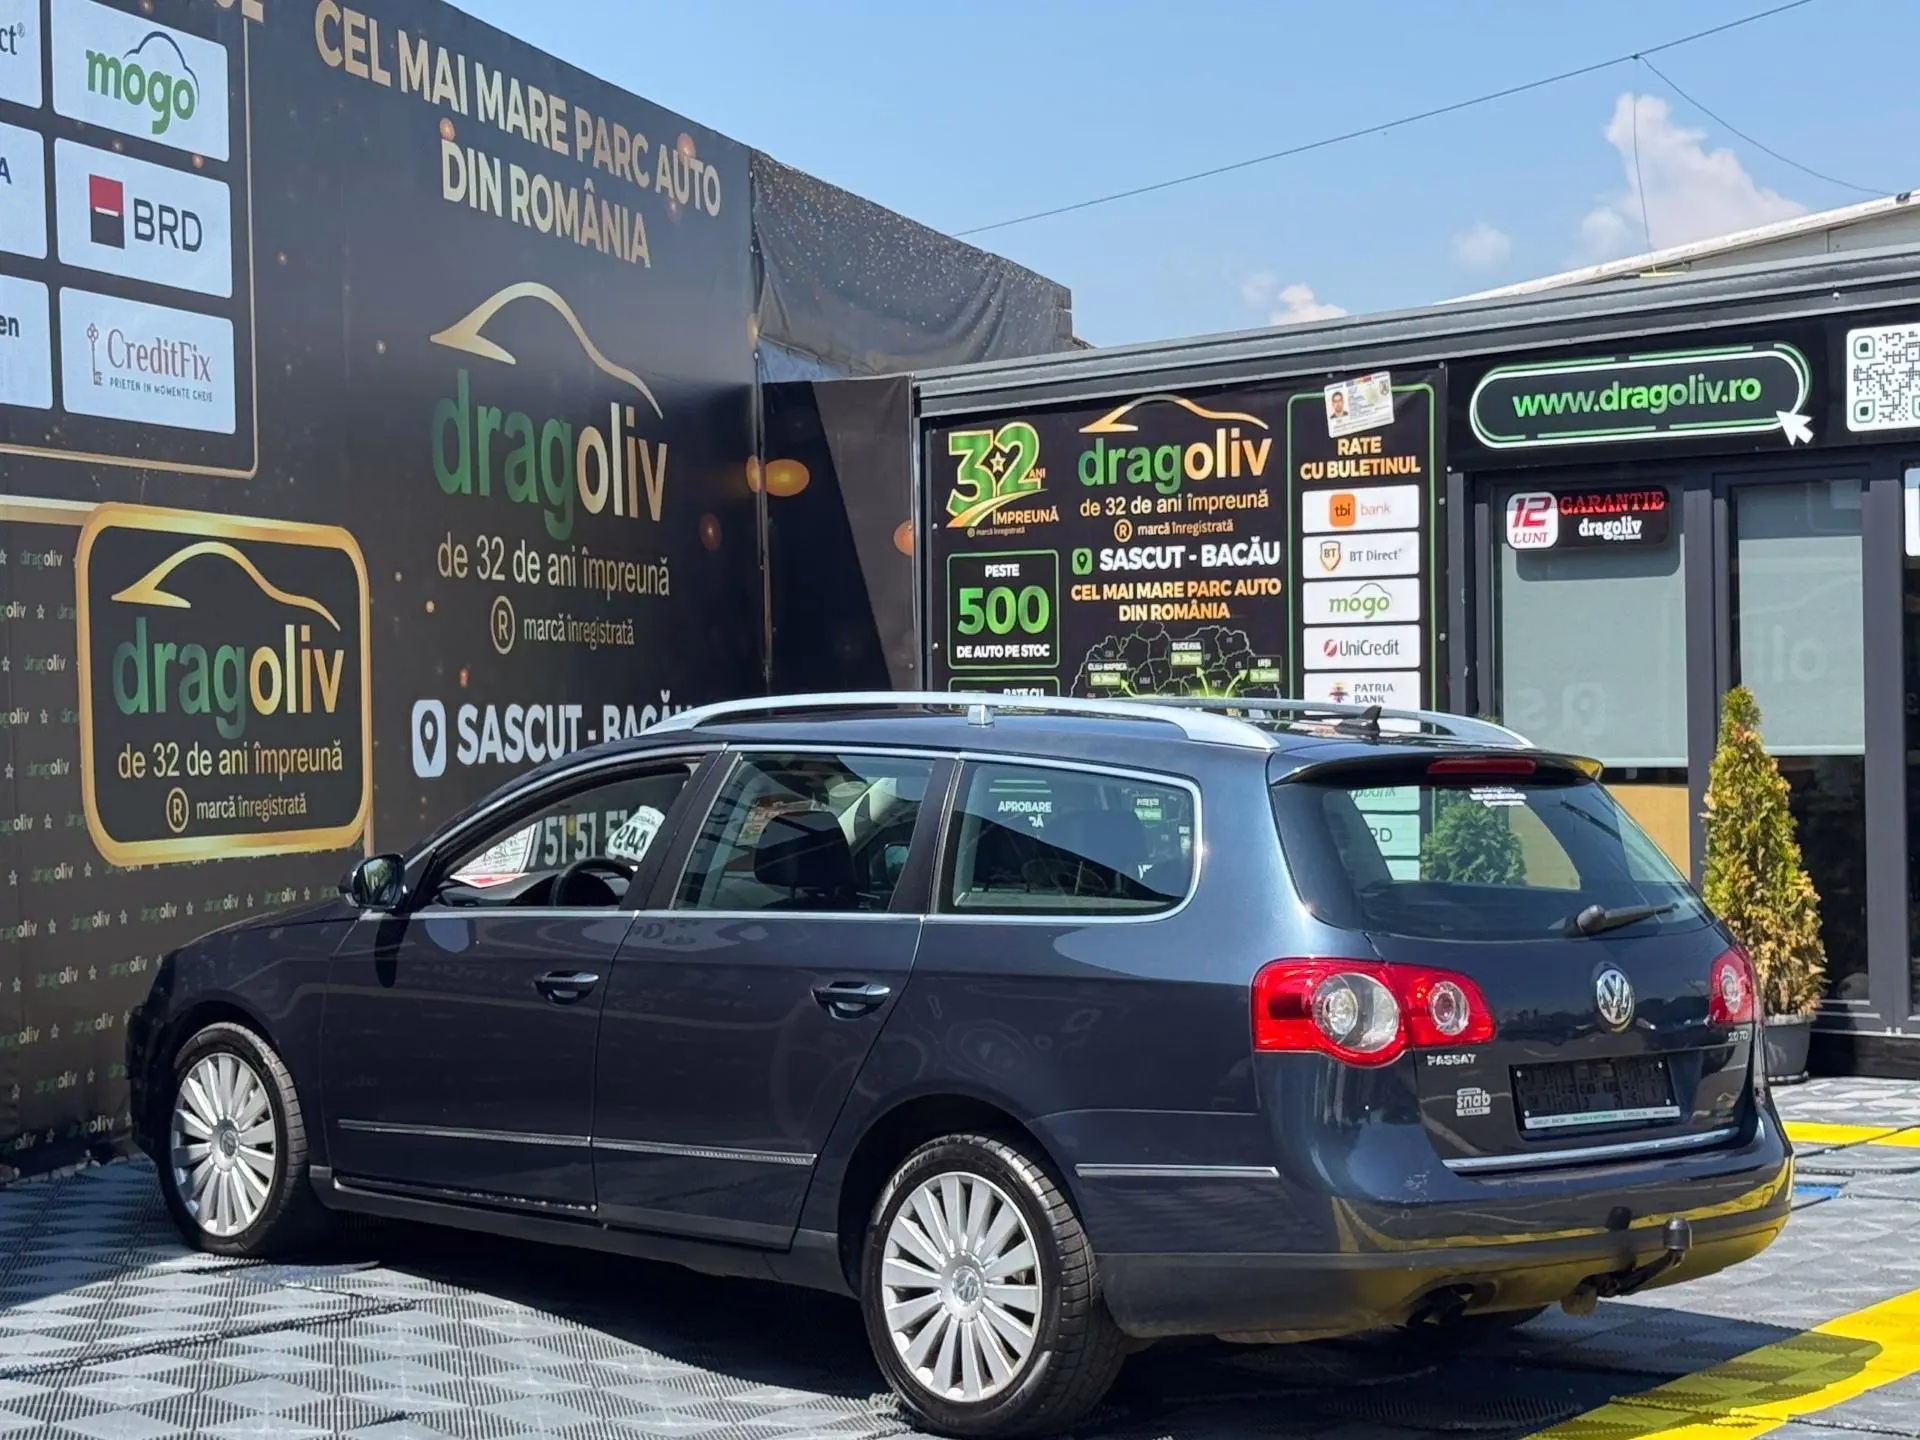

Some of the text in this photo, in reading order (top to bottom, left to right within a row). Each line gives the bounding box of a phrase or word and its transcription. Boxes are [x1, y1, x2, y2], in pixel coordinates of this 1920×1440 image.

[86, 50, 195, 135] mogo
[314, 0, 721, 217] CEL MAI MARE PARC AUTO
[441, 139, 651, 269] DIN ROMÂNIA
[133, 197, 203, 252] BRD
[107, 328, 212, 383] CreditFix
[109, 376, 141, 391] PRIETEN
[1511, 373, 1762, 417] www.dragoliv.ro
[430, 367, 668, 541] dragoliv
[1338, 436, 1382, 455] RATE
[1077, 426, 1273, 494] dragoliv
[1300, 456, 1422, 480] CU BULETINUL
[1029, 467, 1046, 480] ANI
[1080, 488, 1269, 516] de 32 de ani împreună
[1335, 503, 1391, 517] tbi bank
[1512, 490, 1666, 528] 12 GARANTIE
[992, 505, 1060, 526] ÎMPREUNĂ
[1578, 515, 1643, 541] dragoliv
[1137, 520, 1170, 537] marcă
[1172, 519, 1234, 538] înregistrată
[1512, 532, 1549, 544] LUNI
[437, 531, 670, 601] de 32 de ani împreună
[1100, 546, 1185, 572] SASCUT
[1201, 535, 1281, 567] BACĂU
[1350, 550, 1363, 562] BT
[985, 563, 1021, 579] PESTE
[1071, 577, 1282, 601] CEL MAI MARE PARC AUTO
[956, 584, 1050, 636] 500
[1119, 599, 1230, 622] DIN ROMÂNIA
[1328, 596, 1391, 621] mogo
[524, 612, 566, 642] marcă
[566, 613, 635, 651] înregistrată
[956, 643, 1050, 659] DE AUTO PE STOC
[1339, 639, 1400, 657] UniCredit
[112, 616, 345, 740] dragoliv
[1354, 682, 1395, 693] PATRIA
[1354, 694, 1386, 705] BANK
[456, 702, 582, 767] SASCUT
[118, 739, 343, 782] de 32 de ani împreună
[196, 795, 236, 820] marcă
[238, 793, 308, 824] înregistrată
[997, 800, 1053, 813] APROBARE
[1426, 1052, 1477, 1067] PASSAT
[1456, 1089, 1492, 1109] snab
